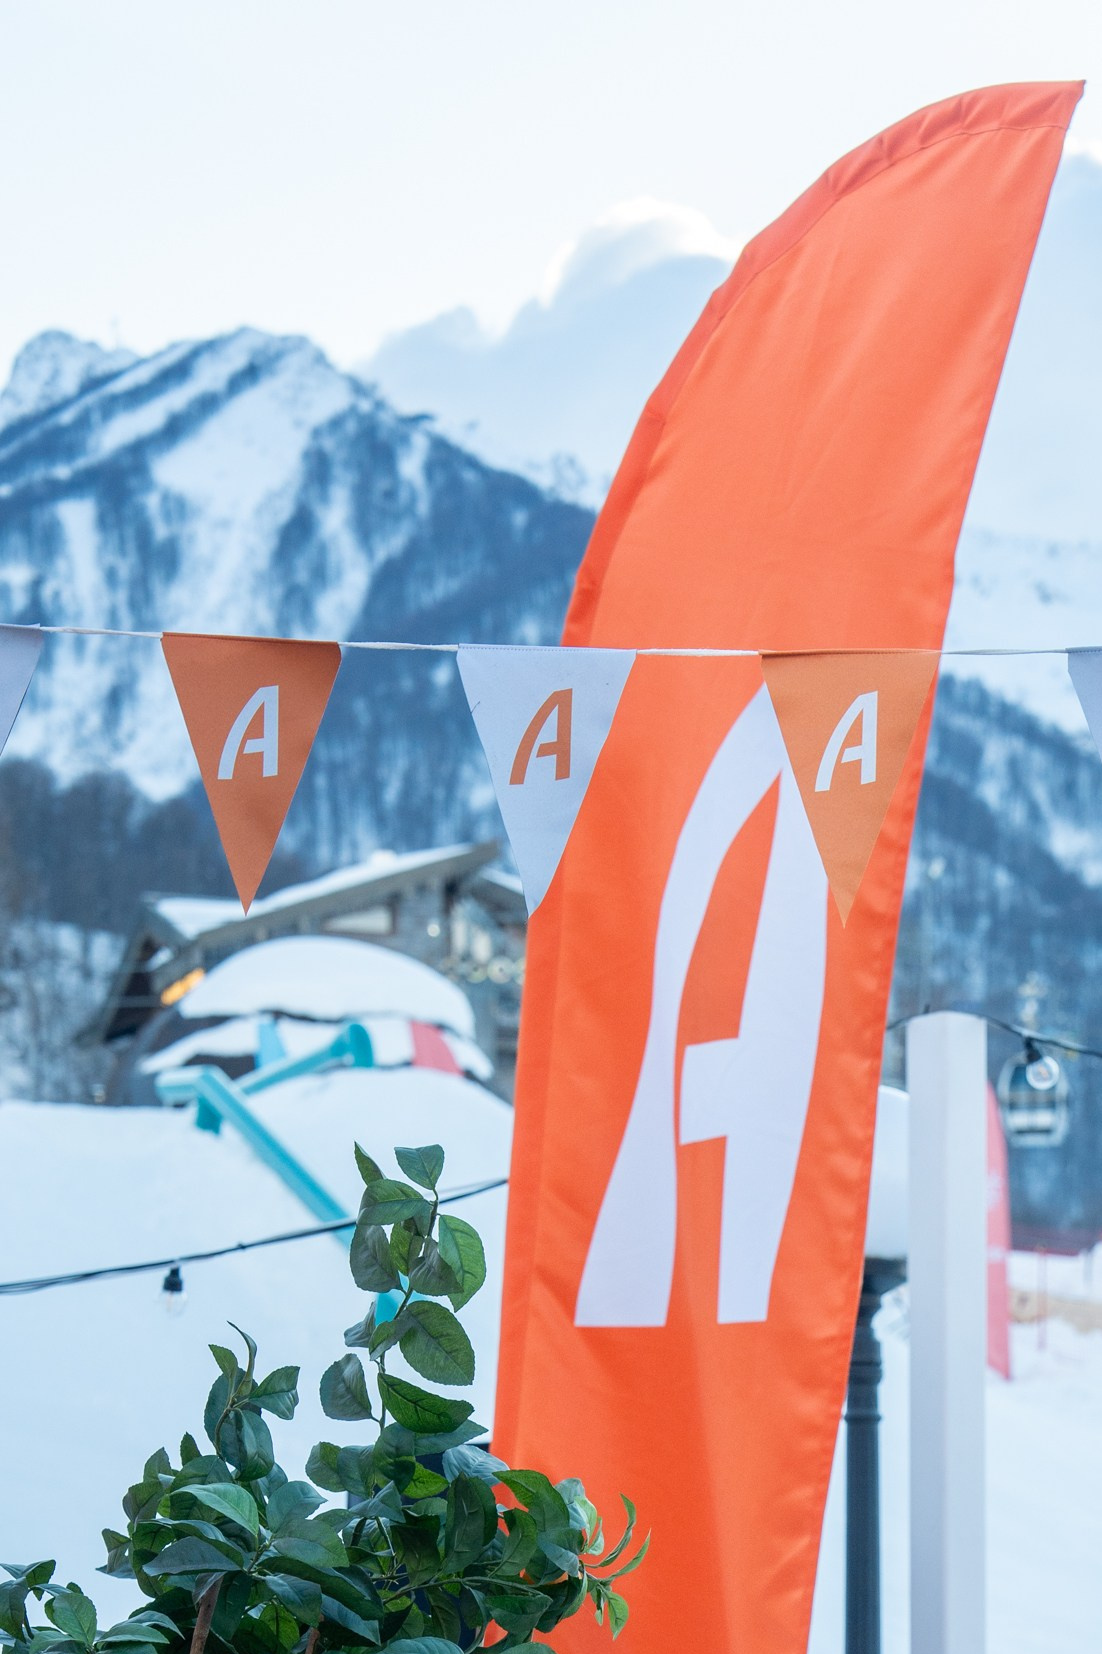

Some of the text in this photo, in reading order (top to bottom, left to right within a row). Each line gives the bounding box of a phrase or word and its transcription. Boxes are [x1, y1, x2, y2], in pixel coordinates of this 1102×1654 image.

[217, 684, 279, 780] A
[509, 687, 573, 786] A
[814, 690, 878, 793] A
[573, 679, 829, 1328] A
